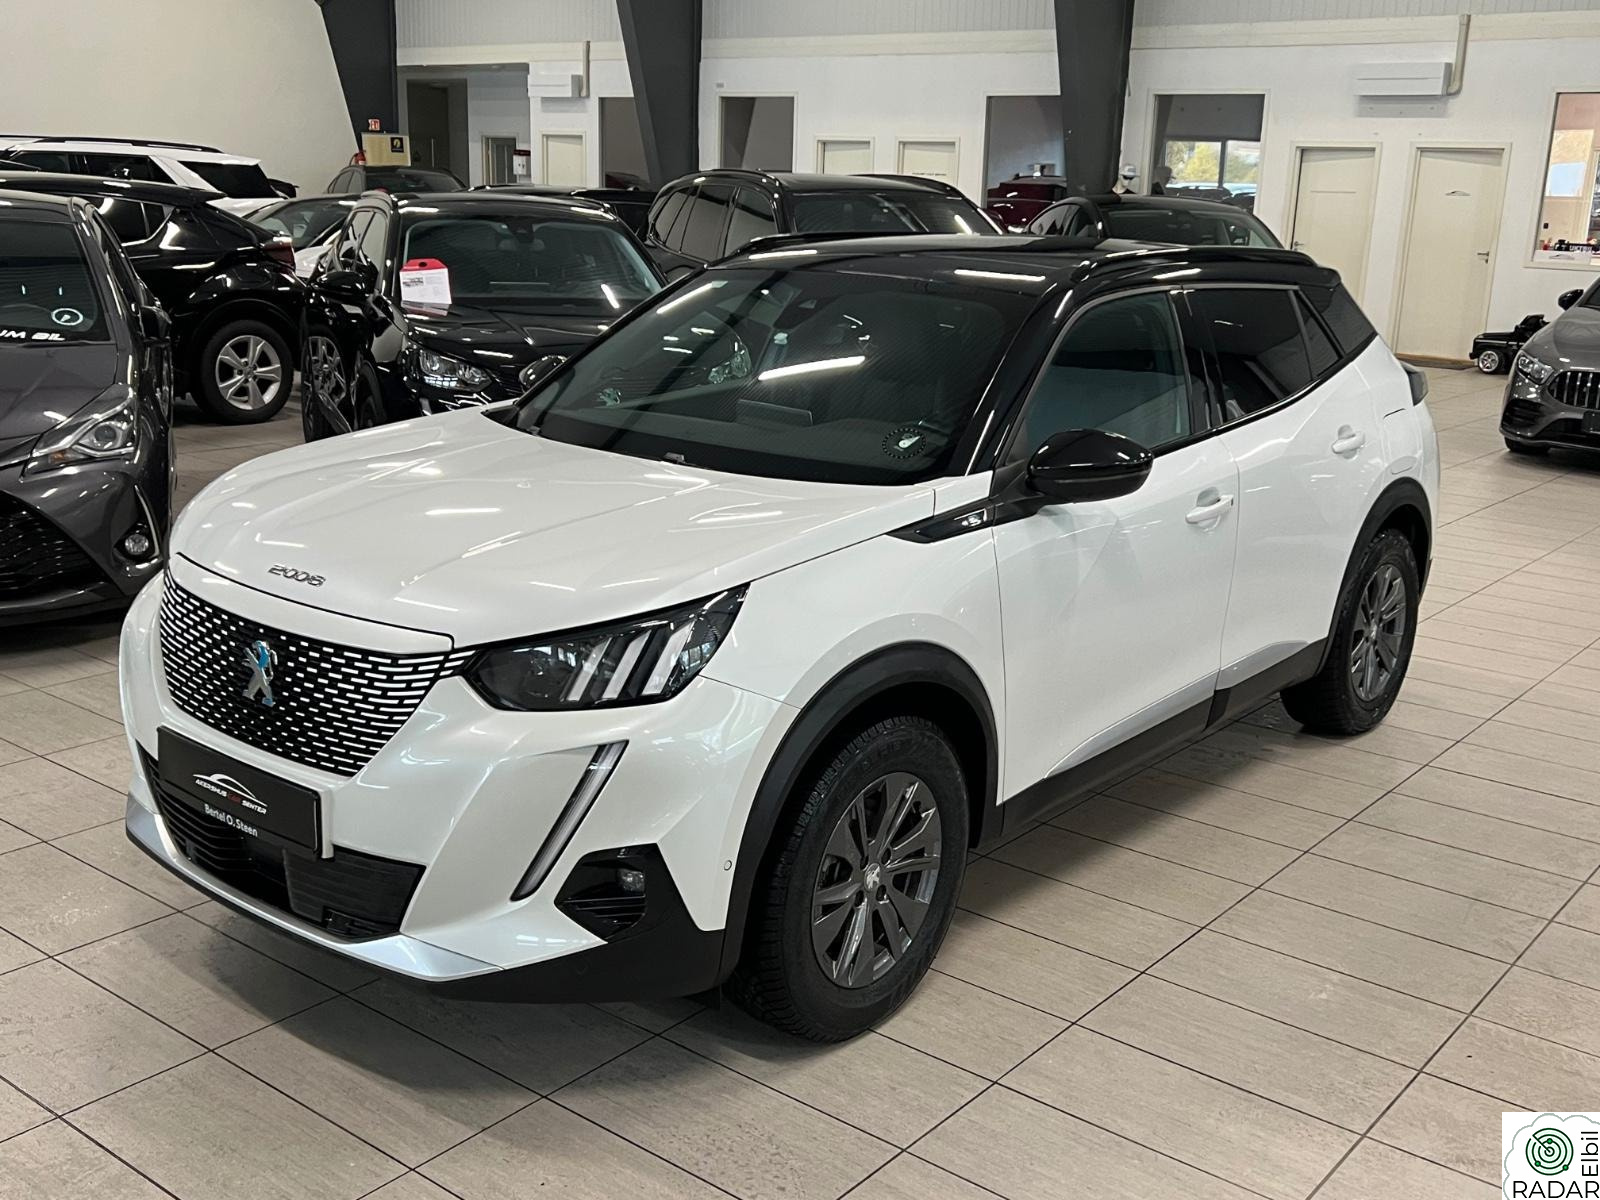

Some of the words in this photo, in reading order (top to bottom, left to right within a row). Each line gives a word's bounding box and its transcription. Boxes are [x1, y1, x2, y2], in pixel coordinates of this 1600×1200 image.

[31, 332, 66, 341] BIL
[268, 564, 326, 587] 2008
[195, 779, 227, 797] AKERSHUS
[241, 800, 267, 814] SENTER
[204, 803, 226, 822] Bertel
[226, 814, 236, 827] O.
[235, 818, 258, 837] Steen
